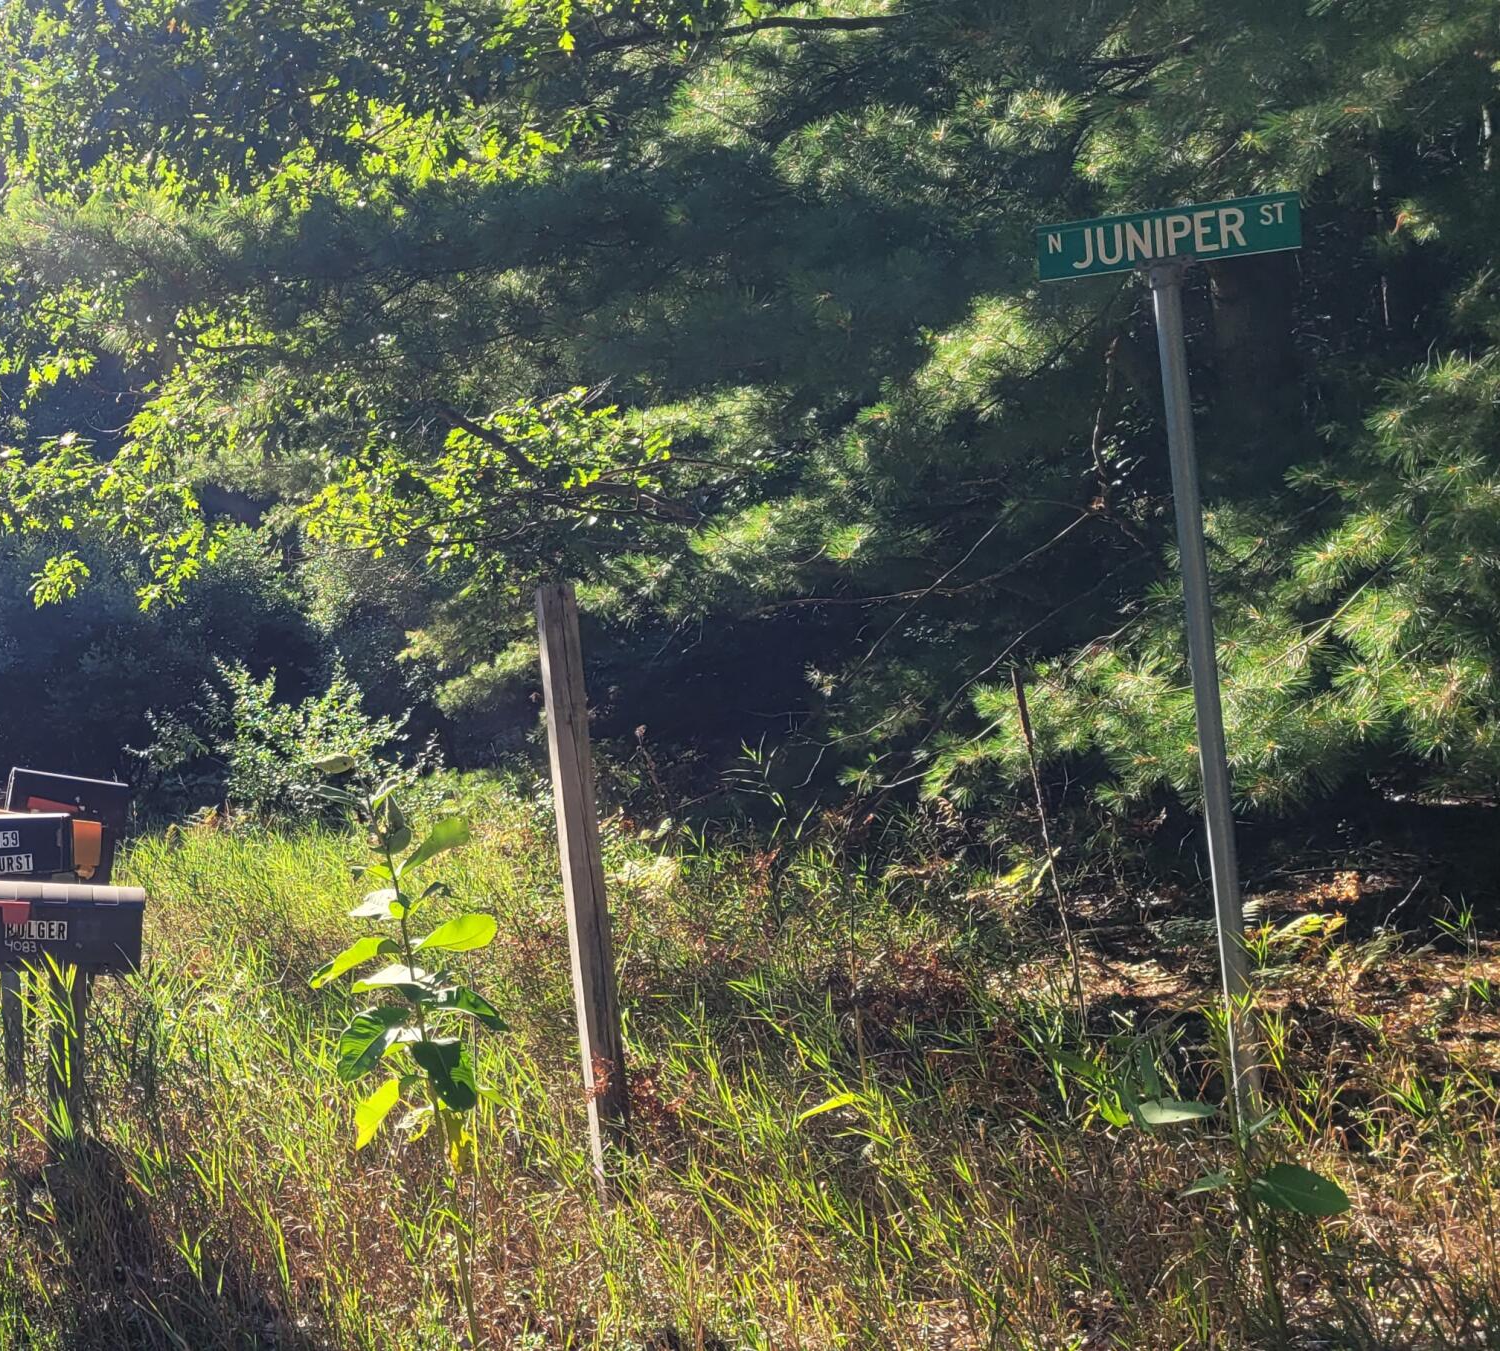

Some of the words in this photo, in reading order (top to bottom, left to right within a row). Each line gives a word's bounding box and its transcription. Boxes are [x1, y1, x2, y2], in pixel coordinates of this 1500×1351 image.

[1047, 232, 1062, 254] N
[1073, 207, 1248, 270] JUNIPER
[1259, 202, 1286, 226] ST
[4, 940, 37, 953] 4083
